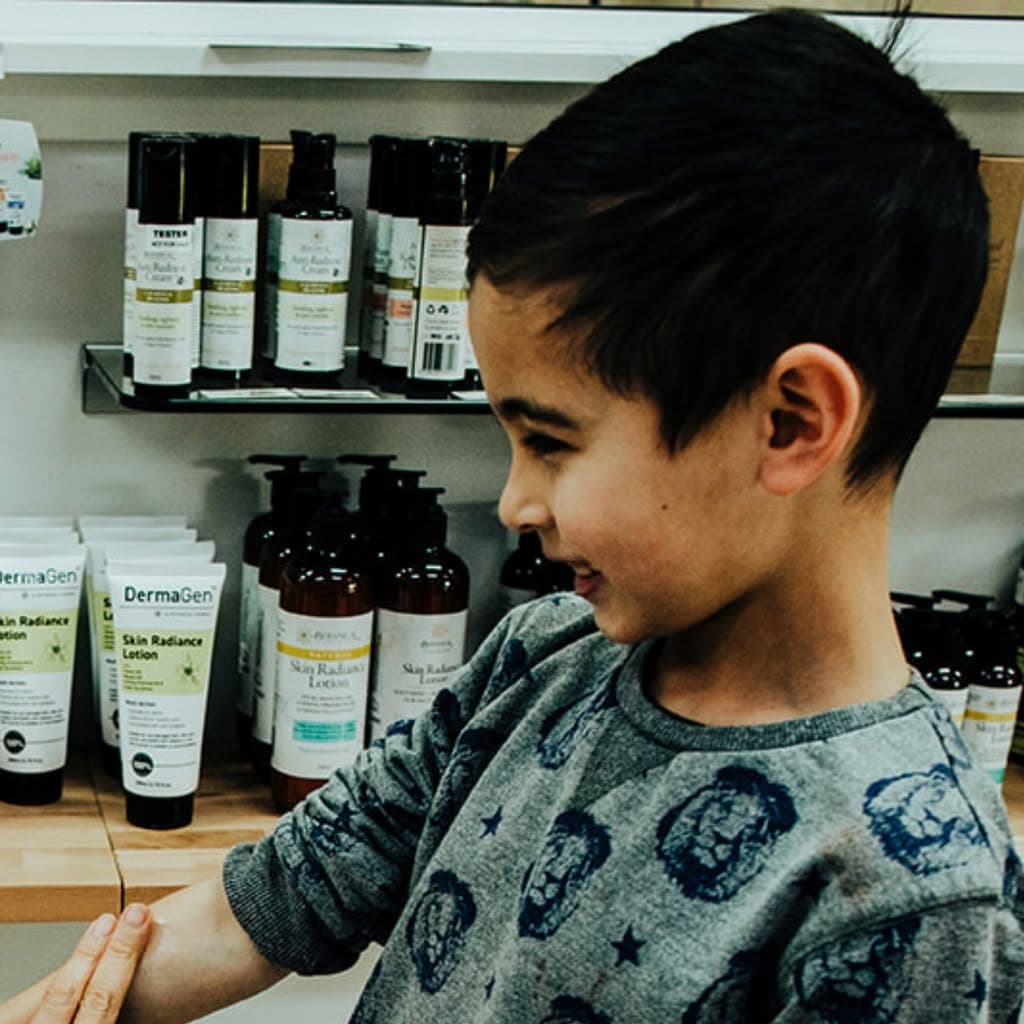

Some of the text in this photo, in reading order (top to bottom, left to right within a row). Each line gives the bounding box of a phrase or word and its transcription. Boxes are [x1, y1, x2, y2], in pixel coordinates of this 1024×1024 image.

[153, 230, 188, 238] TESTER
[124, 586, 213, 603] DermaGen
[20, 616, 69, 628] Radiance
[122, 635, 203, 647] Skin Radiance
[122, 649, 158, 661] Lotion
[289, 661, 315, 675] Skin
[308, 676, 349, 689] Lotion
